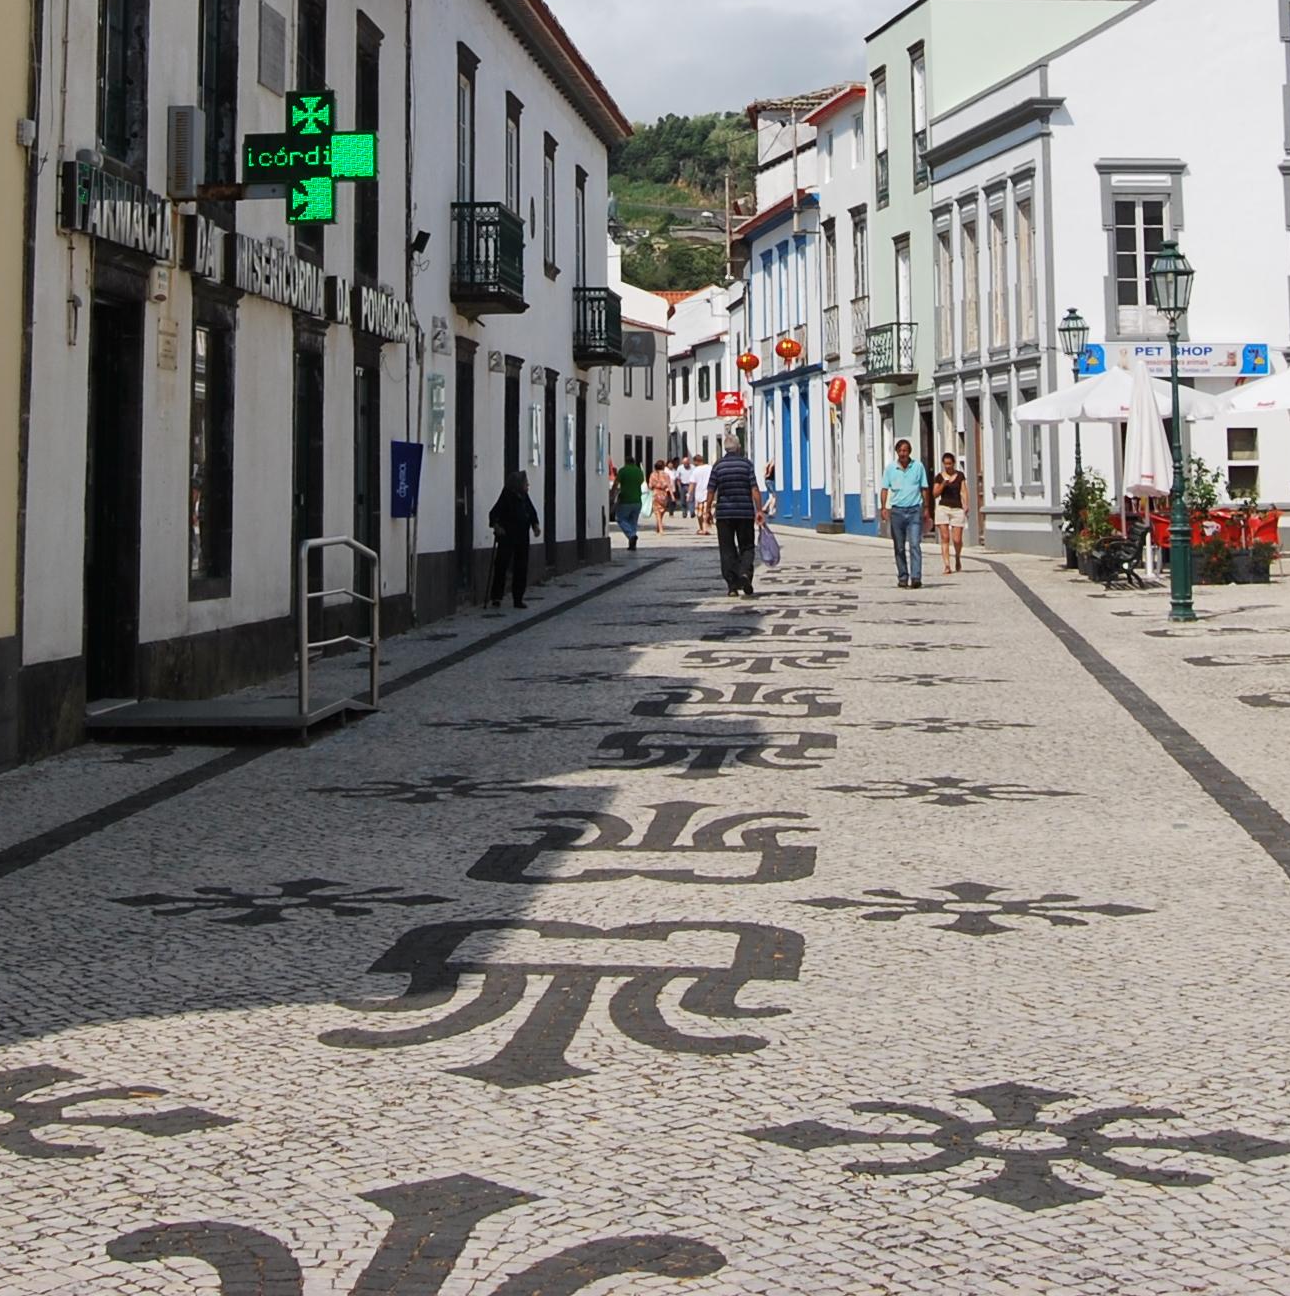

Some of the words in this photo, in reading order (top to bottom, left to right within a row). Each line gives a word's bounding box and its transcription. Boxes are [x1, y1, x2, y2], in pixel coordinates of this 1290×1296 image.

[195, 213, 224, 283] DA
[236, 232, 325, 319] MISERICORDIA
[336, 277, 351, 324] DA
[1135, 347, 1164, 356] PET
